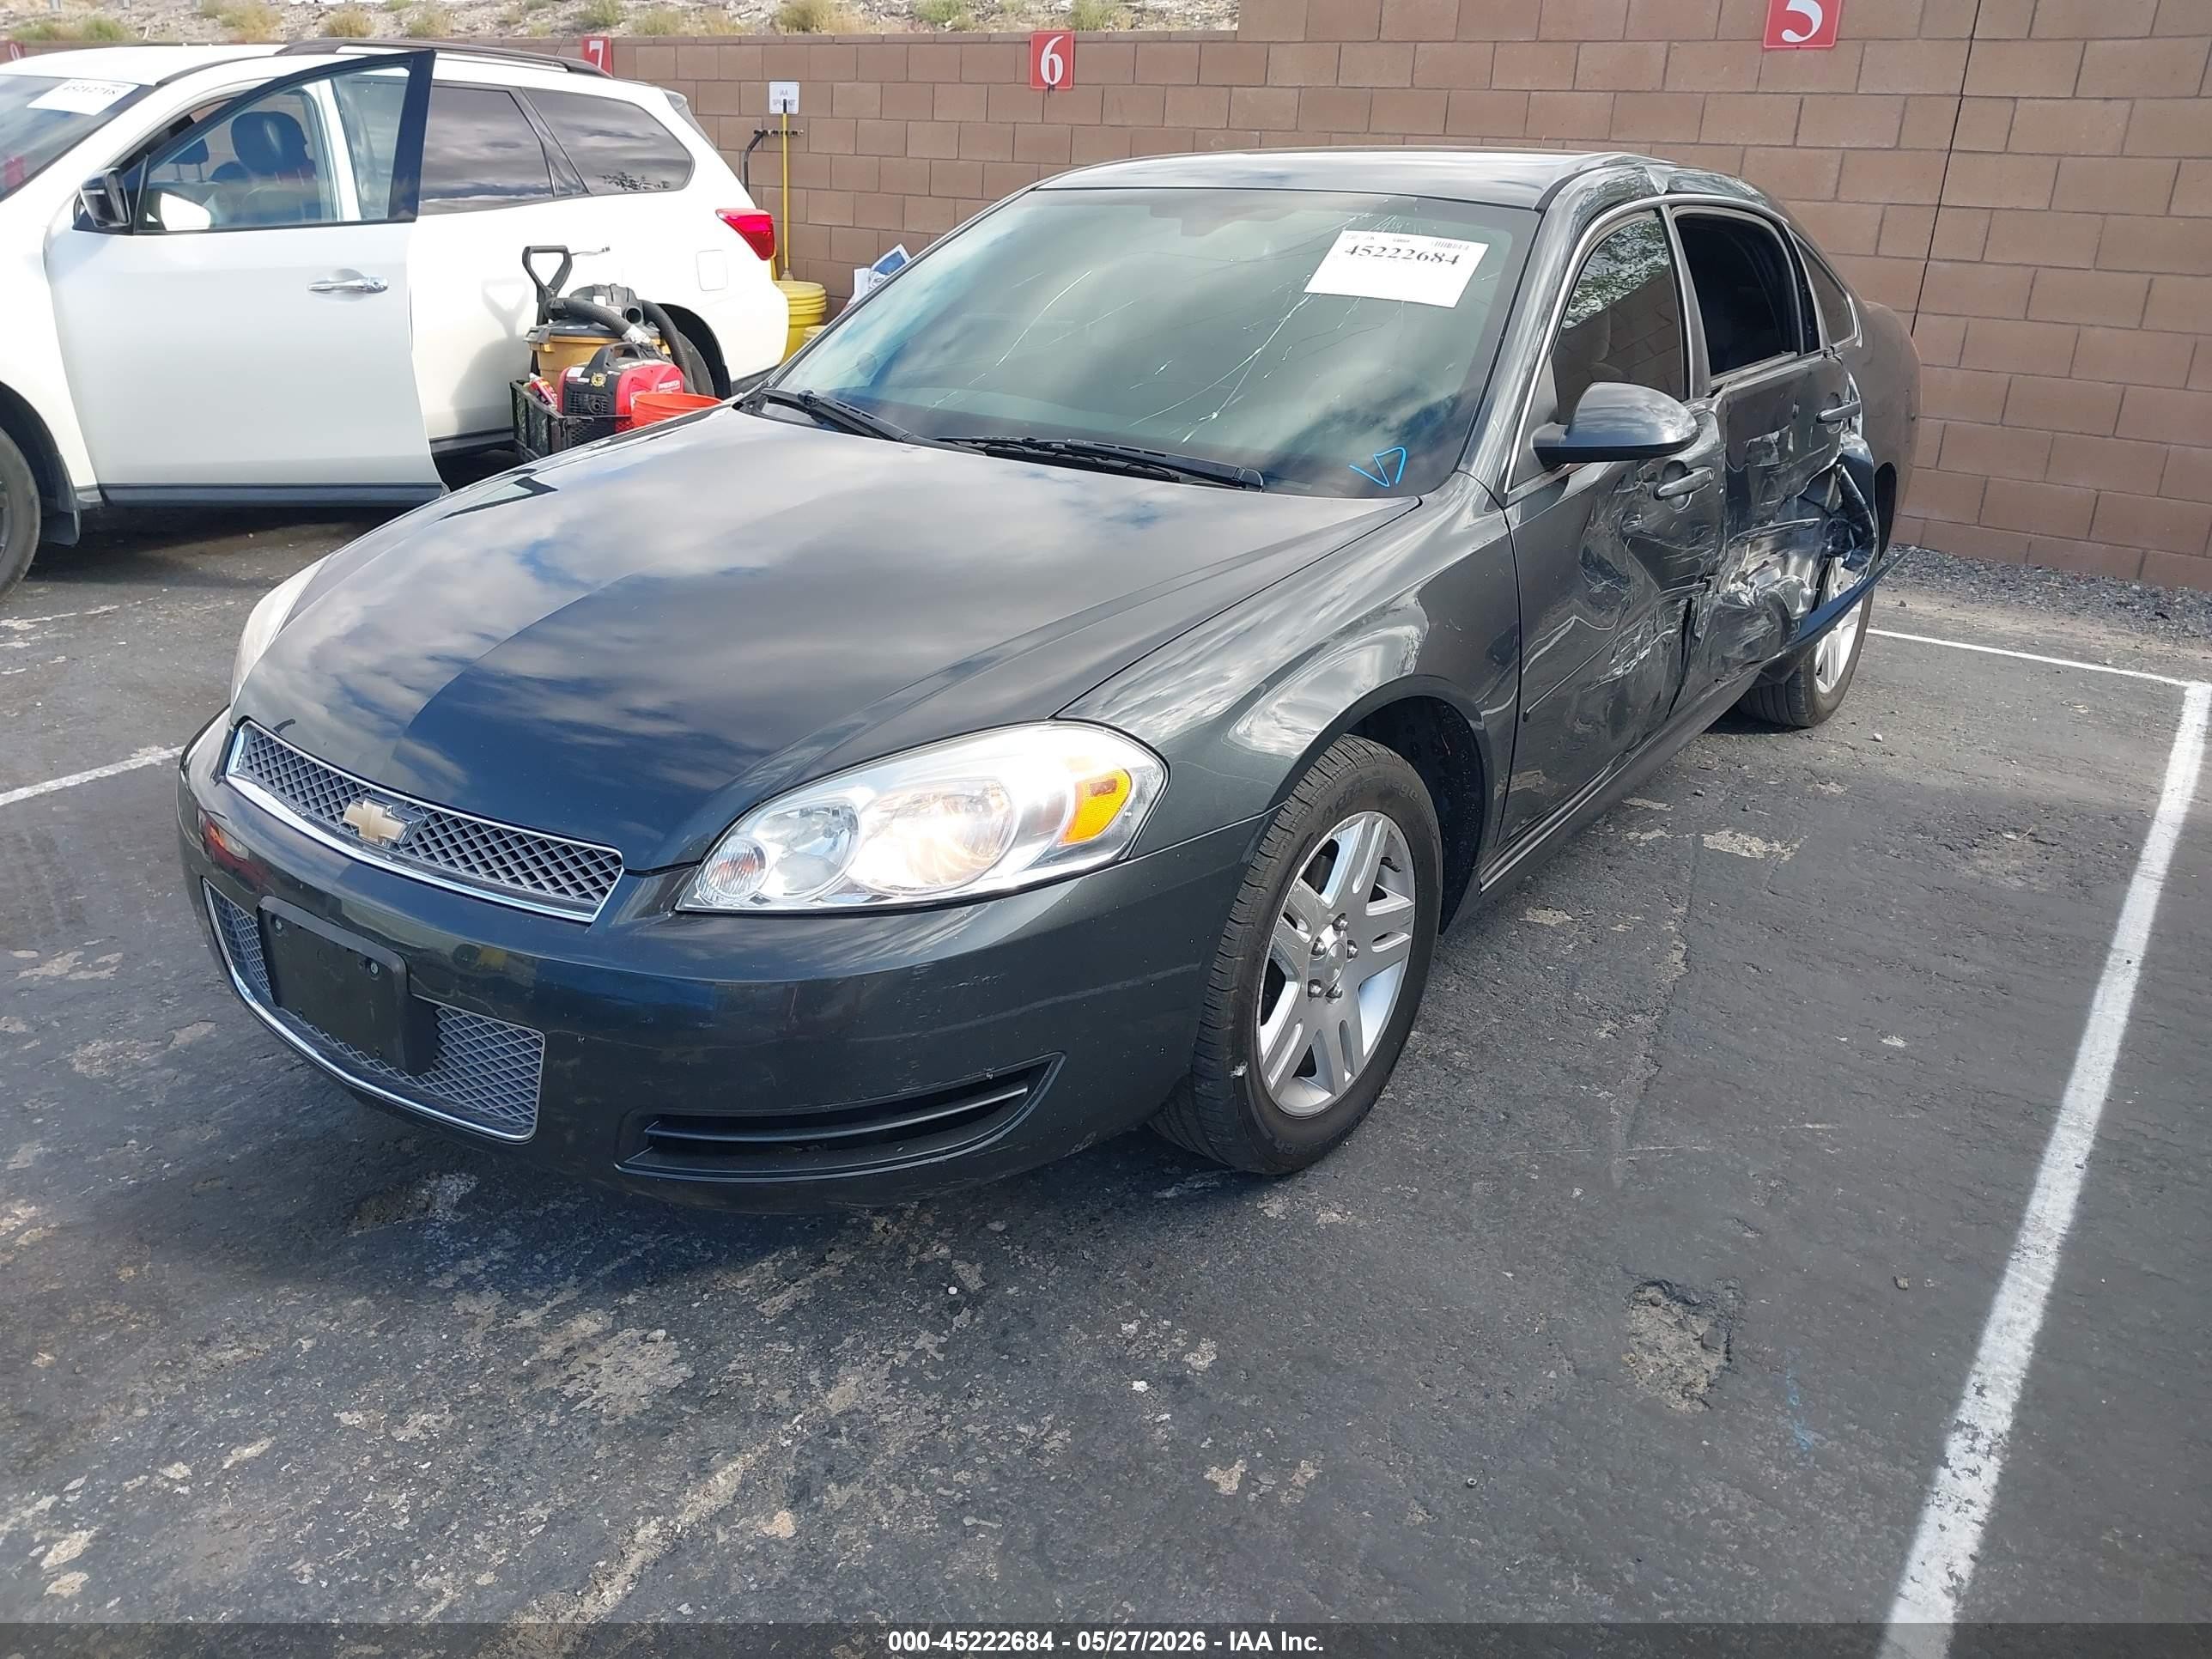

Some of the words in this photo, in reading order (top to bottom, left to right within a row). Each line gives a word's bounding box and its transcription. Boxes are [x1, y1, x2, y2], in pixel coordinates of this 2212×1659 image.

[1781, 0, 1823, 43] 5
[589, 40, 604, 70] 7
[1040, 35, 1065, 85] 6
[1345, 245, 1461, 265] 45222684
